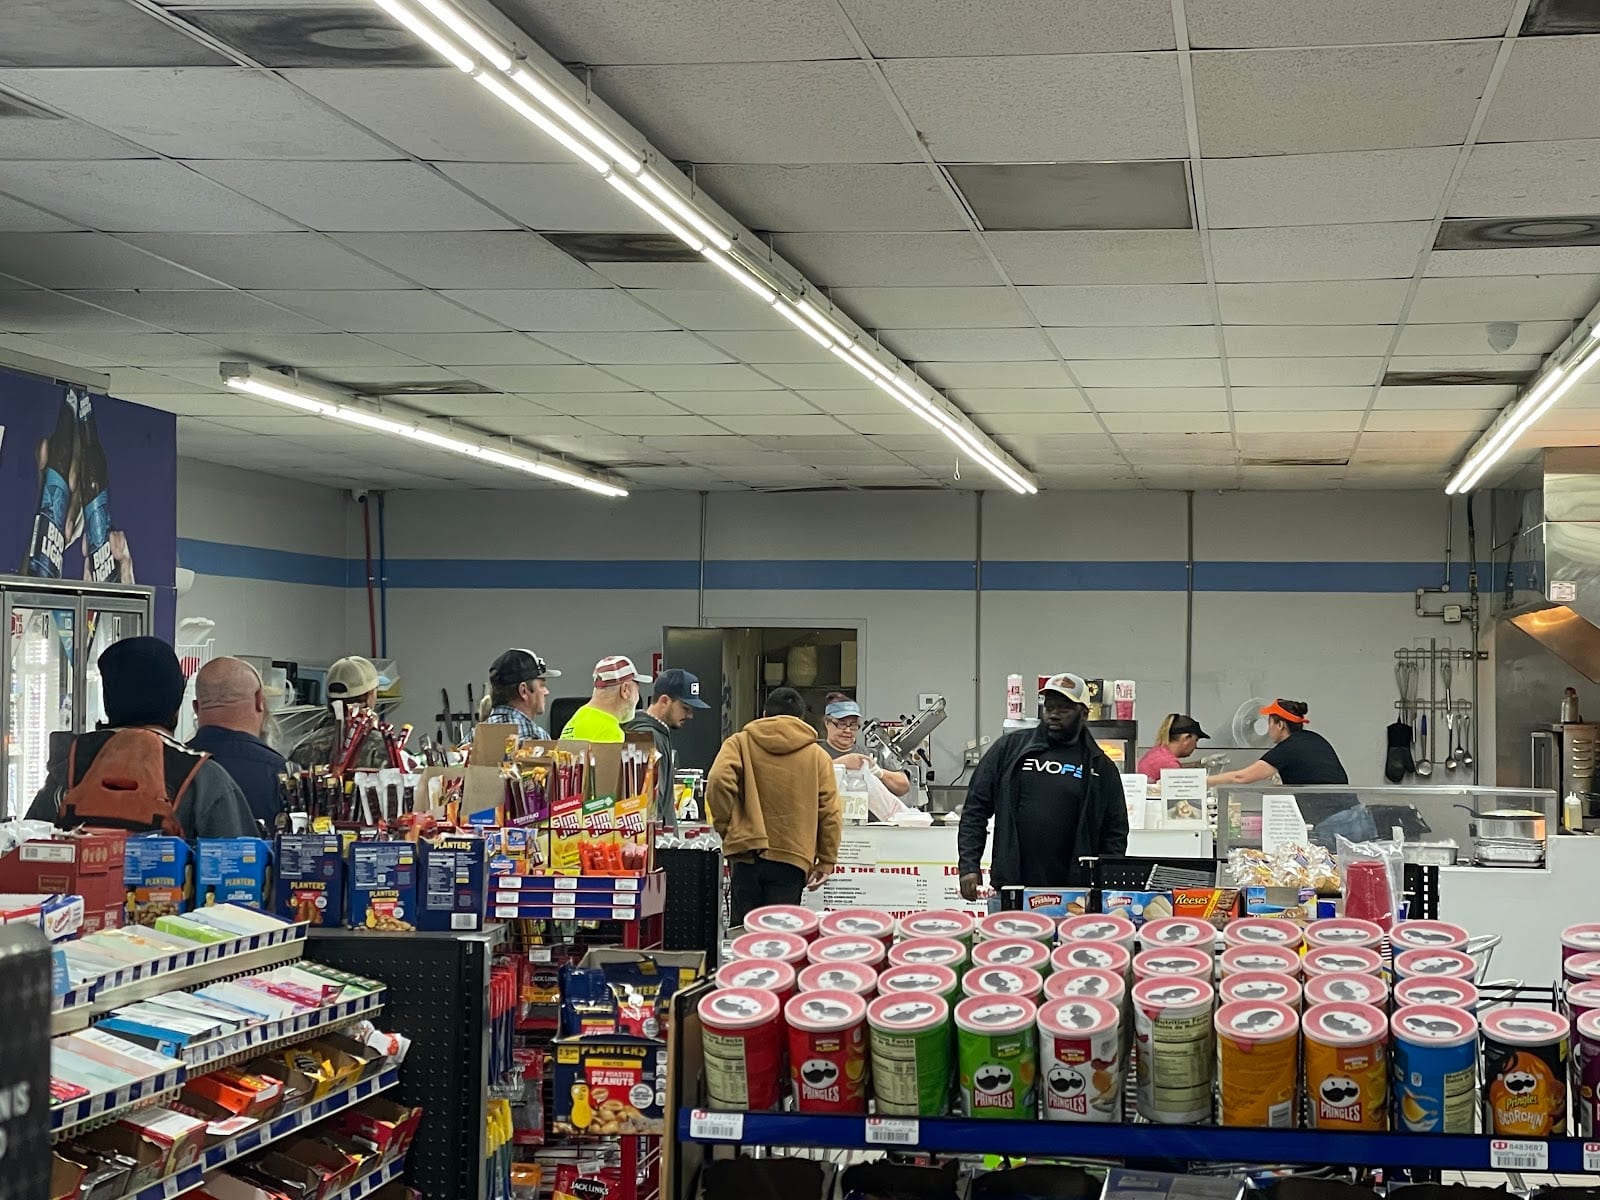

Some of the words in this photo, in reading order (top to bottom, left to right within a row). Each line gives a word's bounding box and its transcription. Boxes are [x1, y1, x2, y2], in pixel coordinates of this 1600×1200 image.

[48, 522, 64, 555] BUD
[93, 541, 111, 570] BUD
[433, 841, 472, 850] PLANTERS
[880, 866, 921, 876] GRILL
[290, 882, 326, 890] PLANTERS
[369, 890, 400, 898] PLANTERS
[581, 1046, 647, 1056] PLANTERS
[591, 1077, 634, 1086] PEANUTS
[802, 1083, 839, 1102] PRINGLES
[974, 1089, 1013, 1108] PRINGLES
[1049, 1095, 1085, 1113] PRINGLES
[1320, 1101, 1360, 1122] PRINGLES
[570, 1181, 589, 1192] JACK
